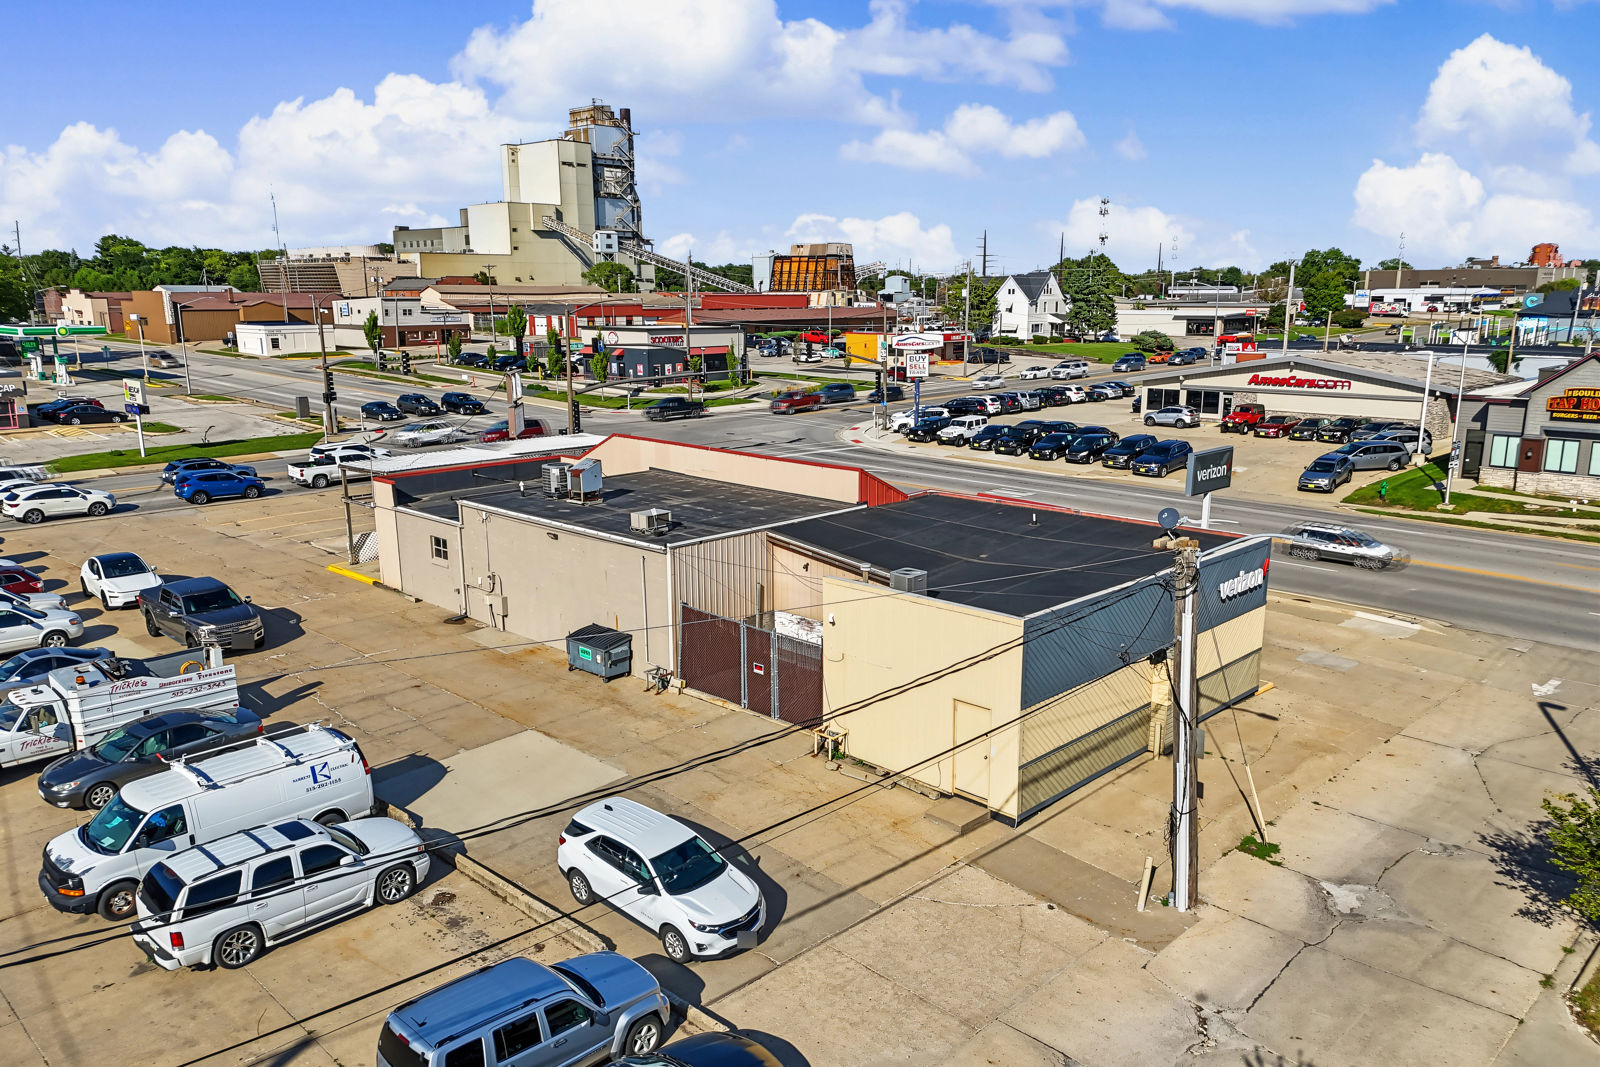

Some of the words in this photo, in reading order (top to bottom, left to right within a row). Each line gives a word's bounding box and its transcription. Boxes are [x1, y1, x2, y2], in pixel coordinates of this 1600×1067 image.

[1550, 397, 1577, 409] TAP
[1197, 464, 1227, 482] verizon
[1219, 569, 1263, 599] verizon
